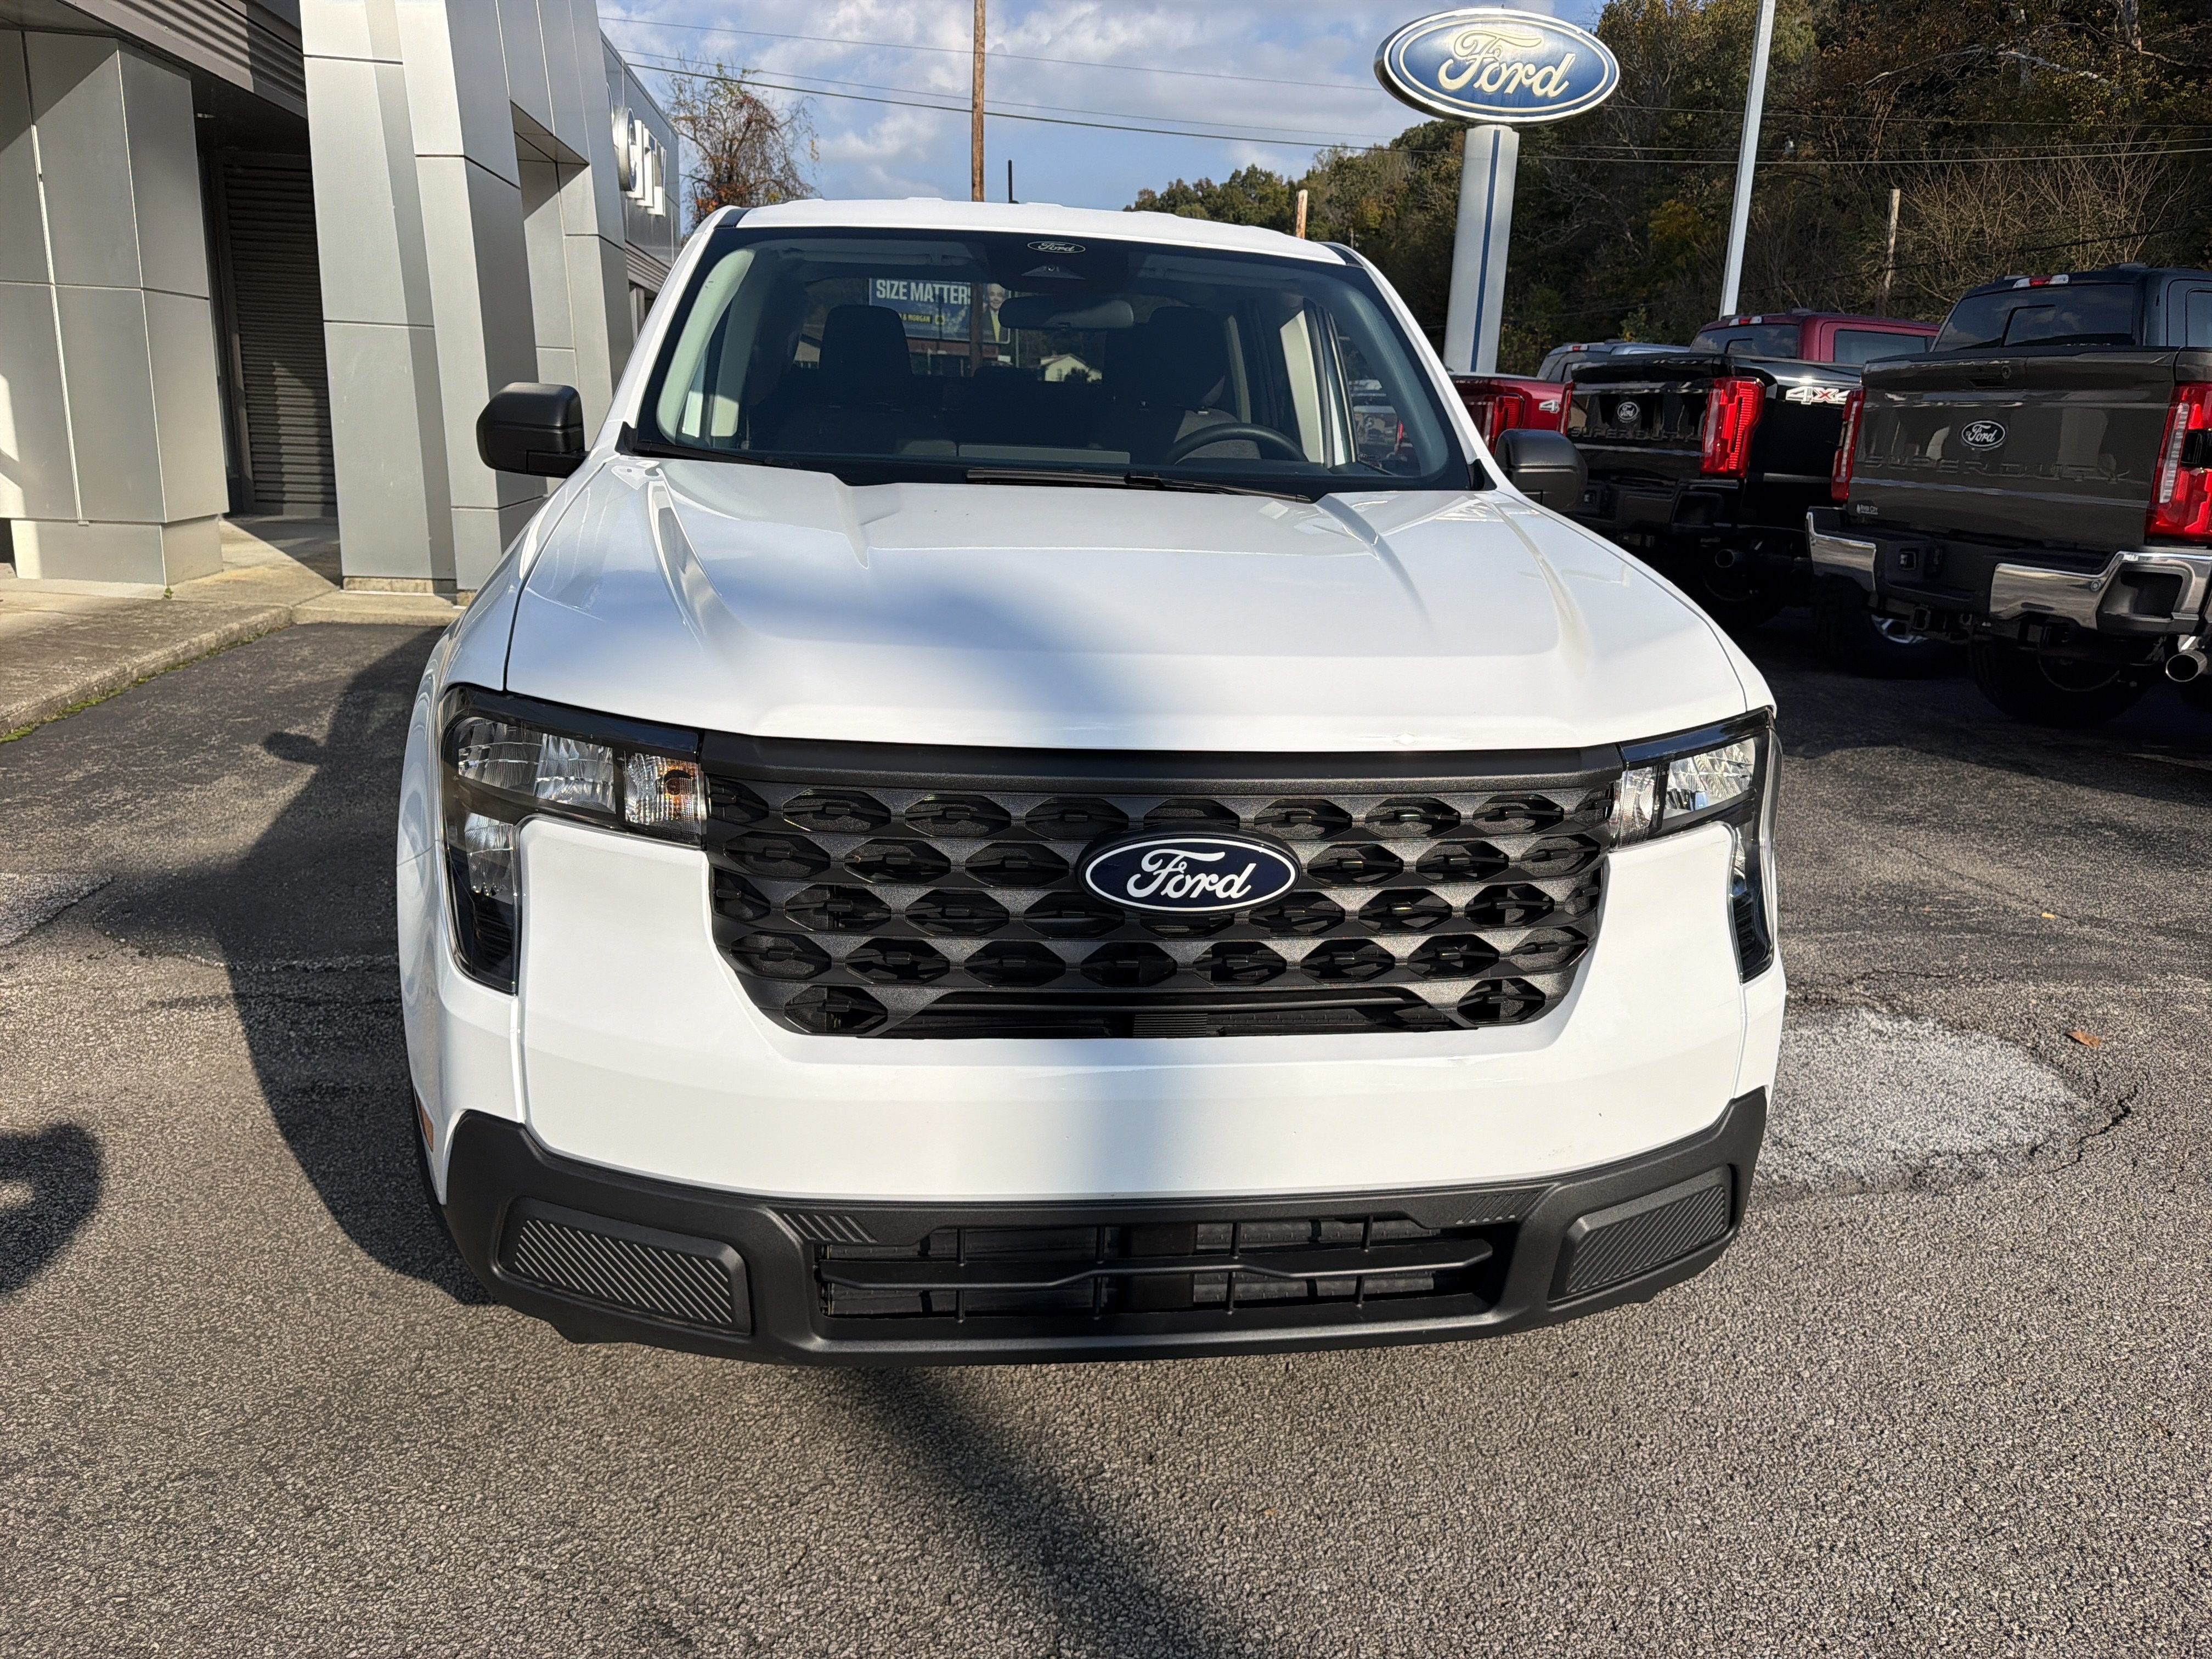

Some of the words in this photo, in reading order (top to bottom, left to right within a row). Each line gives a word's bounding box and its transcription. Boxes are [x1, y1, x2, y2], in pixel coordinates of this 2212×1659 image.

[1437, 30, 1576, 98] Ford
[1037, 242, 1075, 252] Ford
[876, 279, 907, 300] SIZE
[1965, 424, 1998, 444] Ford
[1126, 848, 1257, 899] Ford
